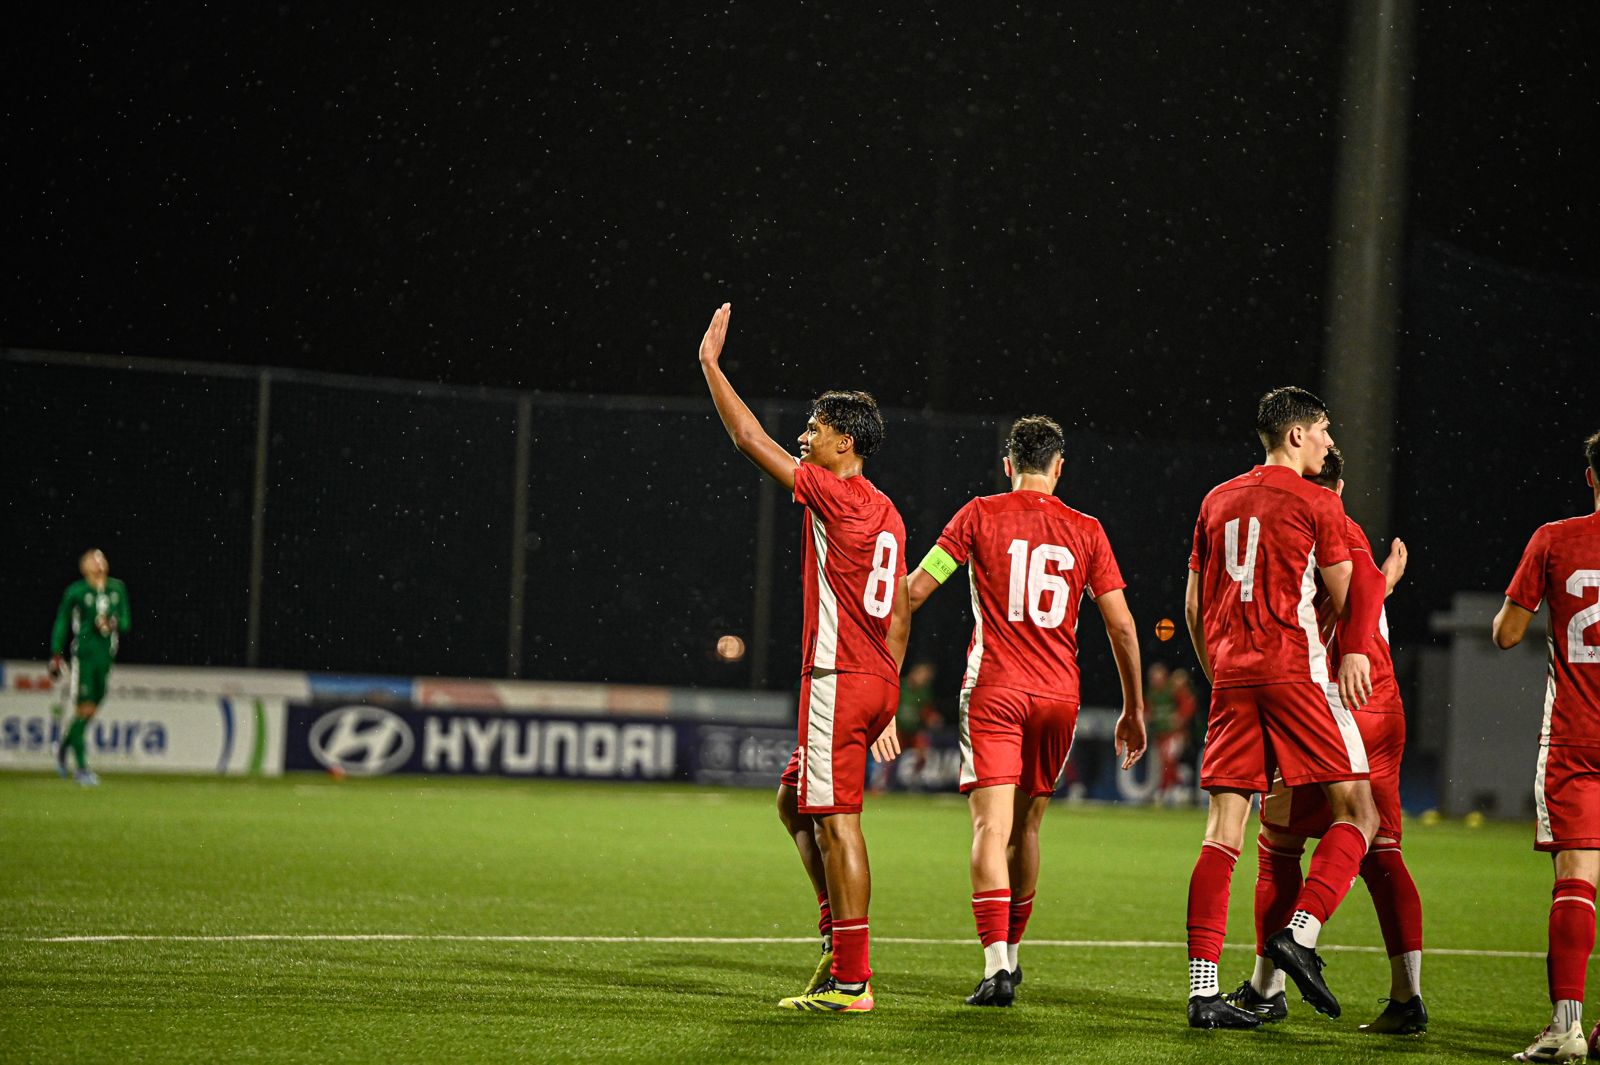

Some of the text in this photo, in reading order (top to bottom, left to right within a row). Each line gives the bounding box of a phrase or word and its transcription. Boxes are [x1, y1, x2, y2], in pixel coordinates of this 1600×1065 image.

[863, 531, 898, 619] 8
[1007, 539, 1075, 629] 16
[1224, 516, 1261, 602] 4
[0, 703, 168, 753] ssiura
[422, 715, 677, 778] HYUNDAI
